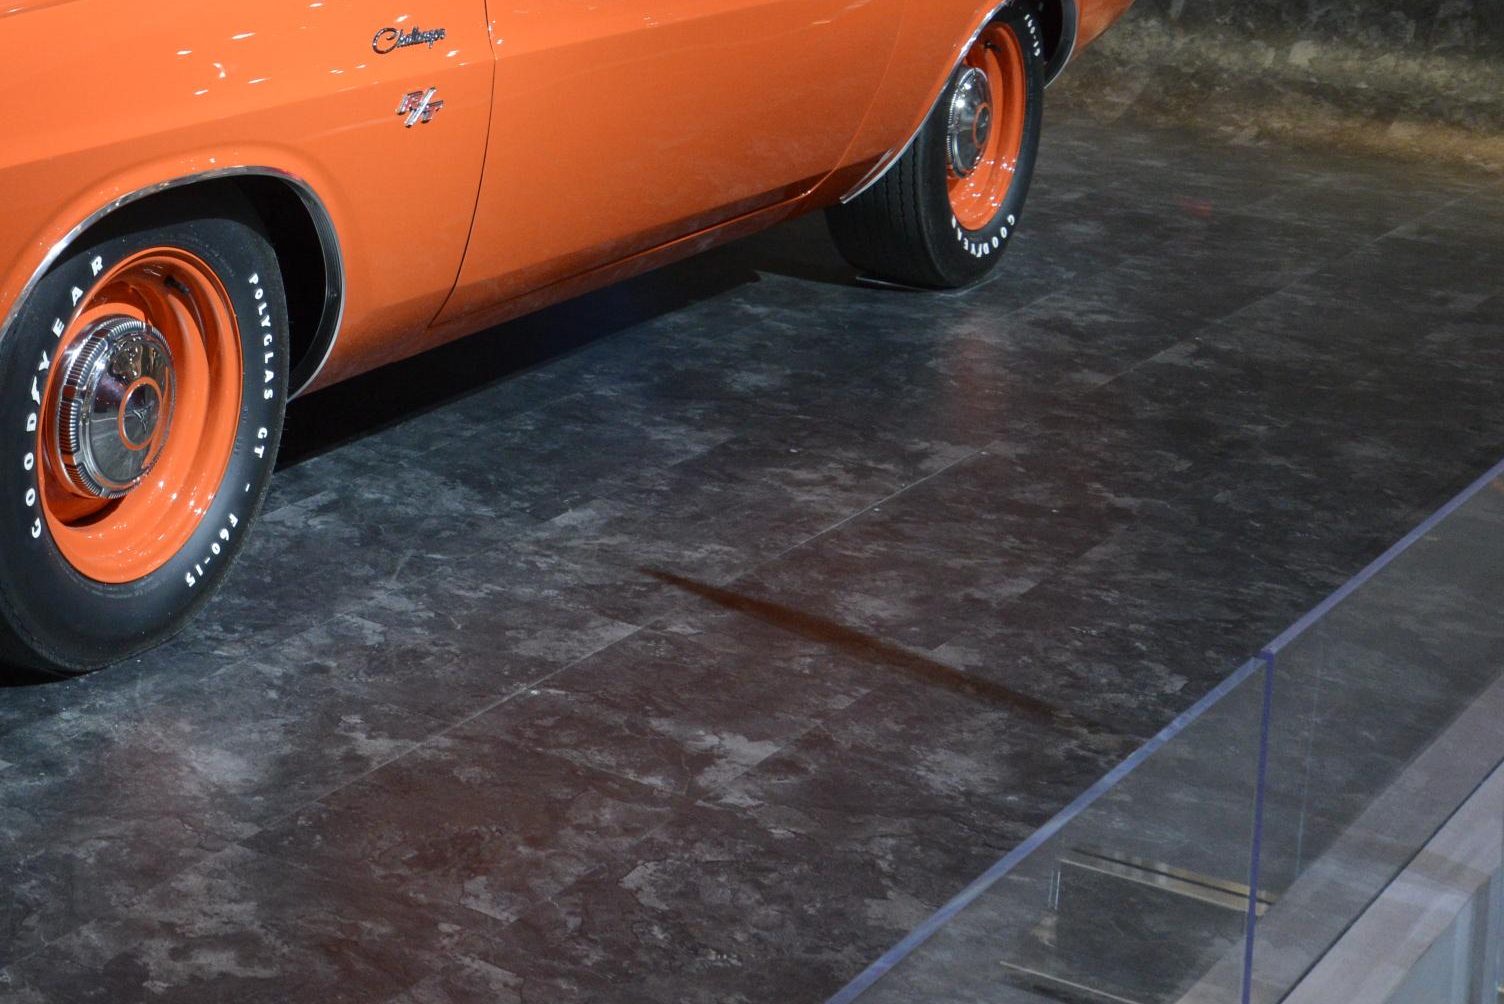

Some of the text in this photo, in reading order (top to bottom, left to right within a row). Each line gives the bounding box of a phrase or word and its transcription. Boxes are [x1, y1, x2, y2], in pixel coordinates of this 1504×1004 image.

[372, 25, 446, 54] Challenger
[397, 86, 444, 128] R/T
[248, 272, 274, 401] POLYGLAS
[23, 255, 103, 539] GOODYEAR
[252, 426, 268, 459] GT
[184, 512, 239, 588] F60-15
